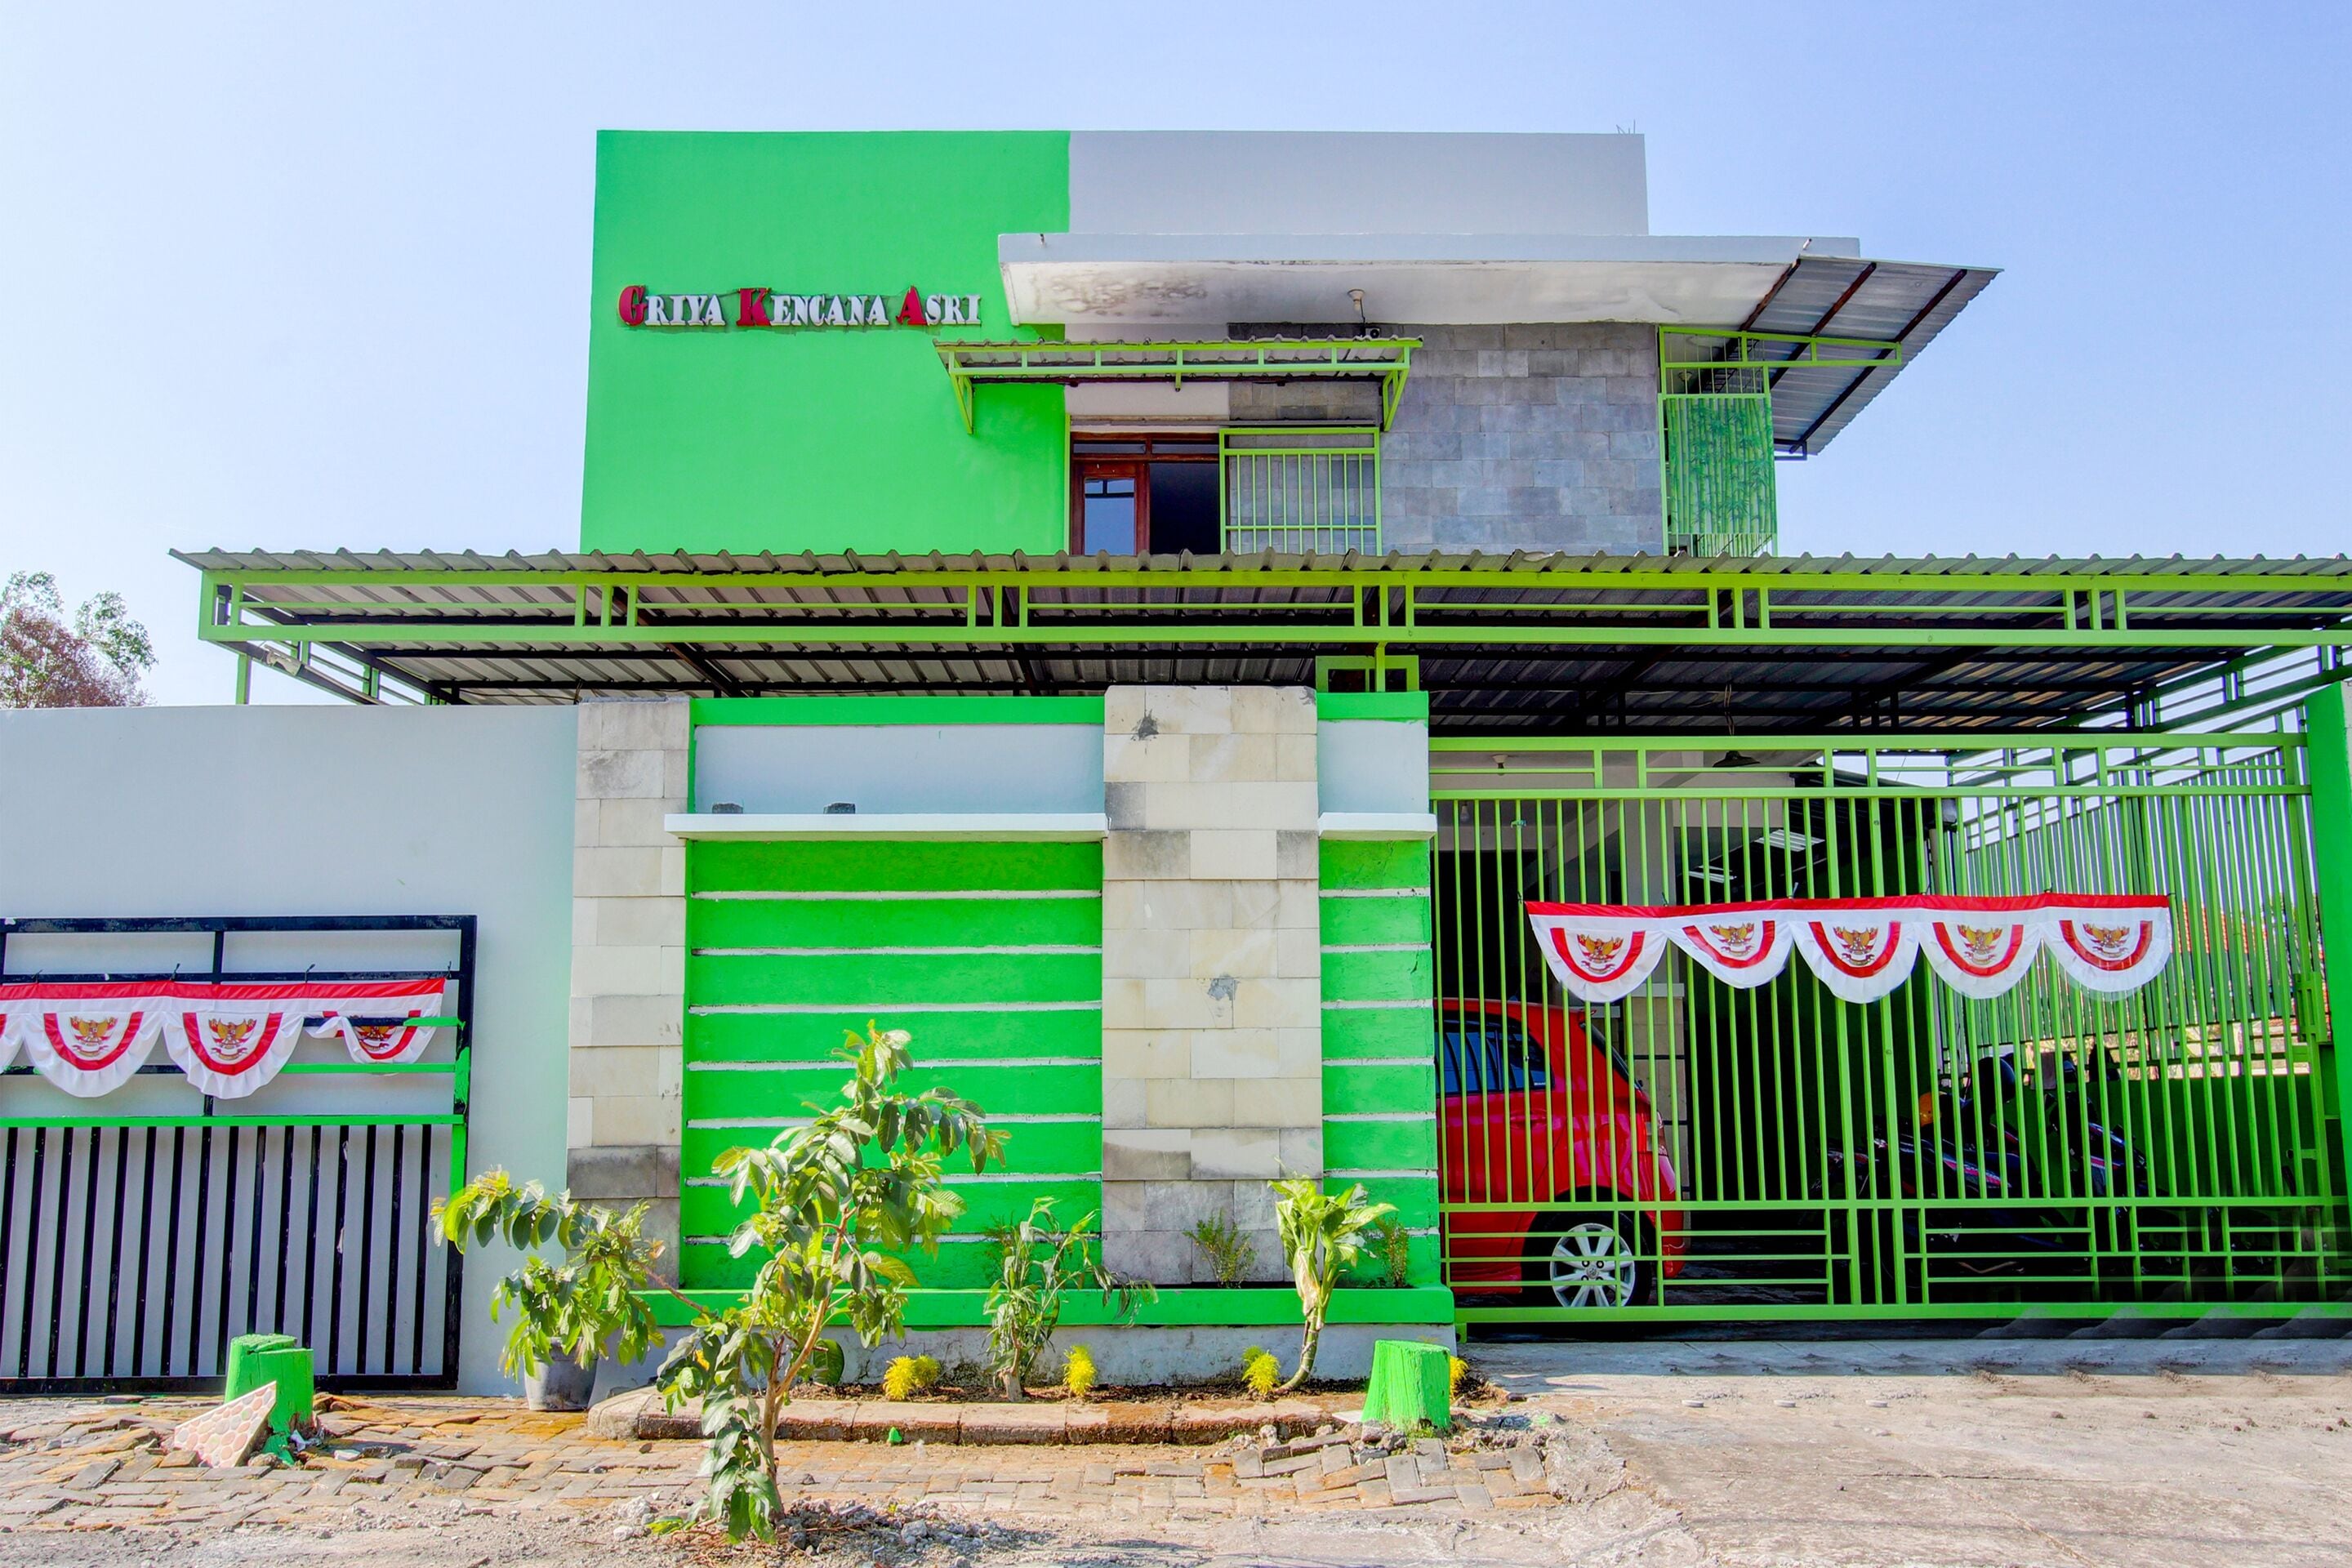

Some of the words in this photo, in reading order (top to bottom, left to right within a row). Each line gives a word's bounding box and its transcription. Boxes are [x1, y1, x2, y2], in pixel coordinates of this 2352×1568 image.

[618, 285, 726, 327] GRIYA
[737, 287, 890, 327] KENCANA
[896, 285, 981, 327] ASRI
